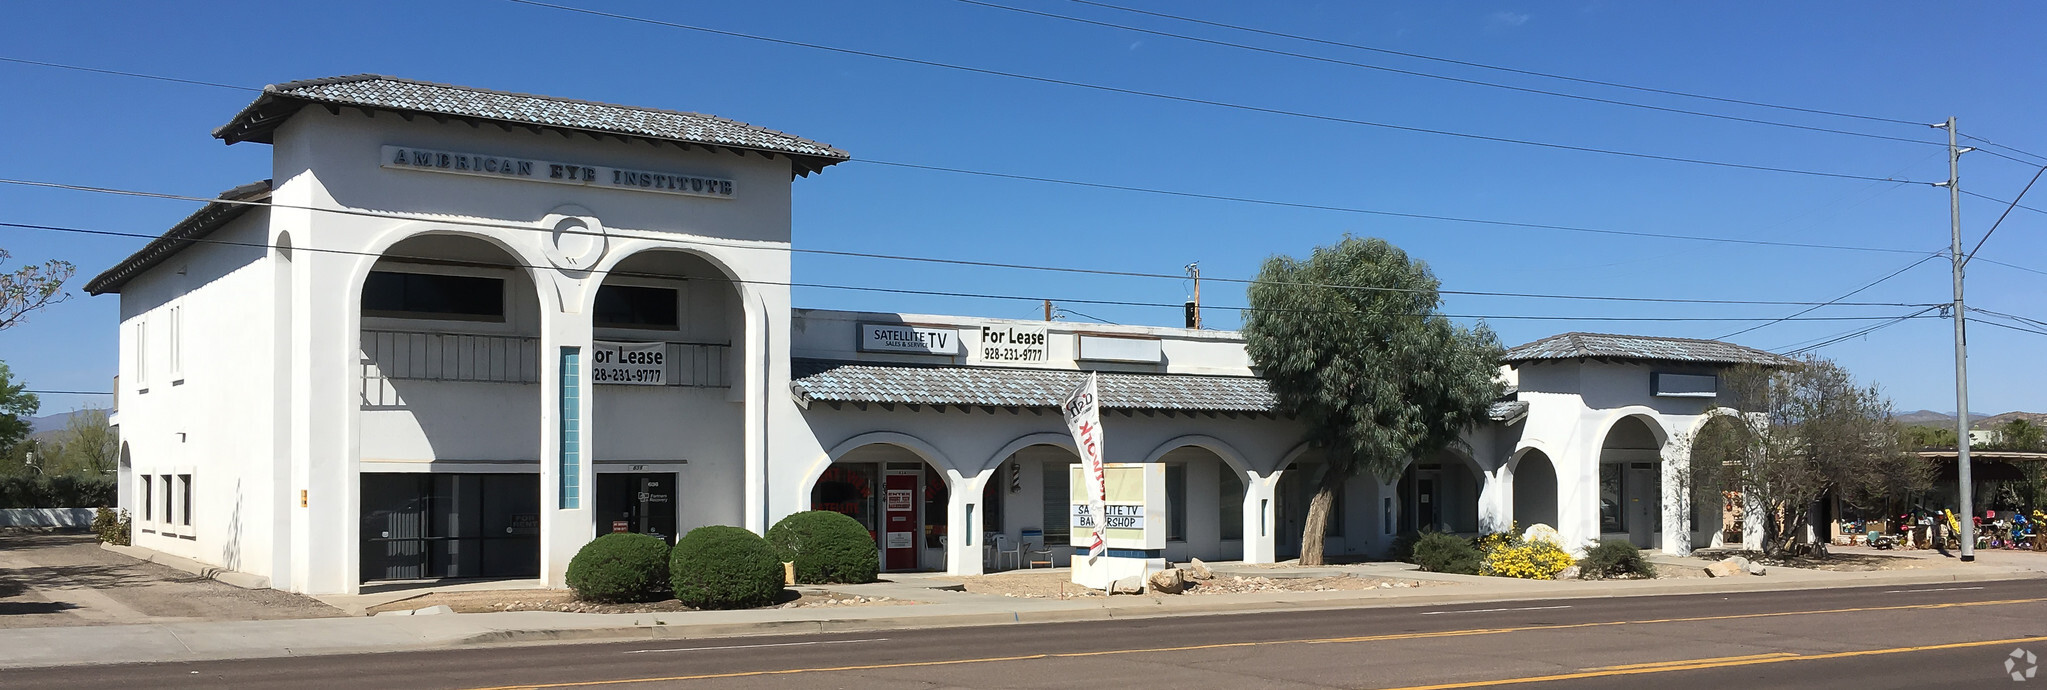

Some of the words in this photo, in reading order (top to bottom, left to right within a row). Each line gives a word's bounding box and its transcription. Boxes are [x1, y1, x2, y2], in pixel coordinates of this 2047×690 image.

[393, 149, 534, 176] AMERICAN
[550, 164, 597, 182] EYE
[613, 169, 734, 196] INSTITUTE
[874, 329, 926, 342] SATELLITE
[928, 332, 947, 349] TV
[982, 326, 1005, 344] For
[1009, 327, 1044, 345] Lease
[907, 341, 929, 349] SERVICE
[594, 350, 613, 364] or
[618, 346, 663, 365] Lease
[984, 347, 1042, 361] 928-231-9777
[594, 368, 661, 383] 28-231-9777
[1078, 505, 1123, 515] SALITE
[1126, 506, 1138, 515] TV
[1080, 517, 1136, 527] BARSHOP
